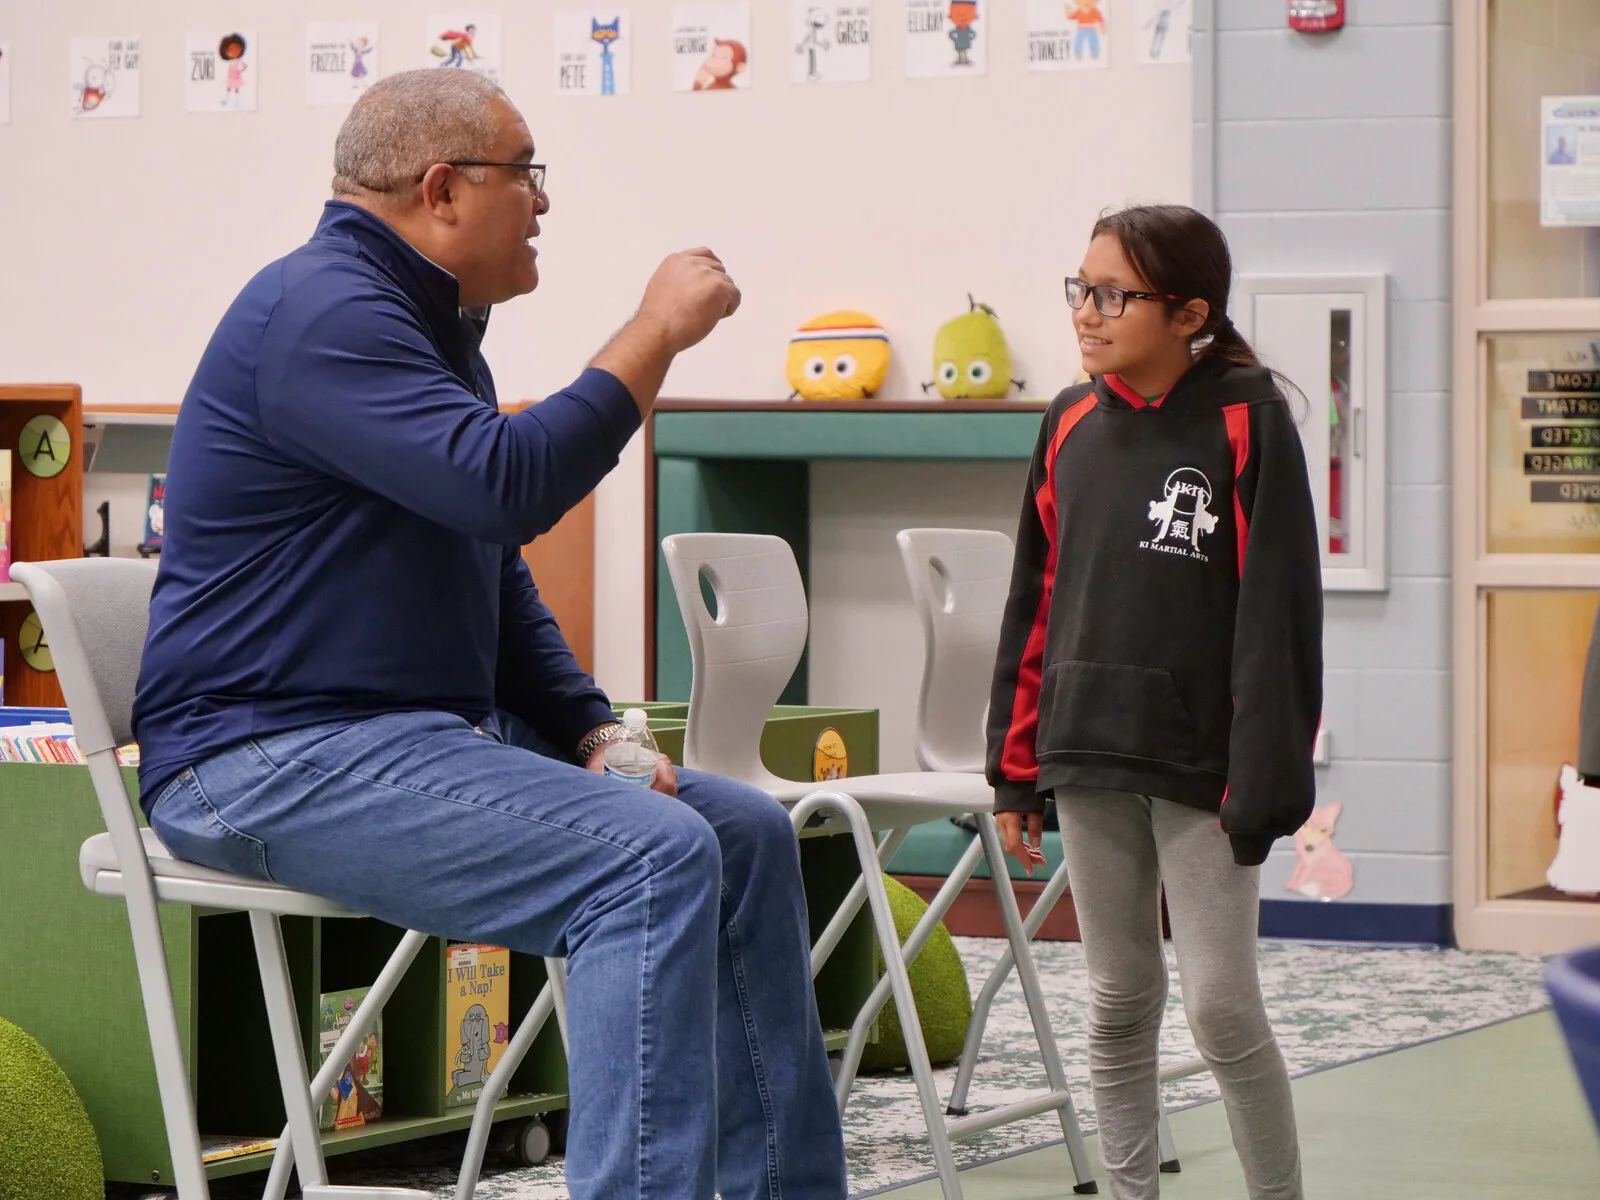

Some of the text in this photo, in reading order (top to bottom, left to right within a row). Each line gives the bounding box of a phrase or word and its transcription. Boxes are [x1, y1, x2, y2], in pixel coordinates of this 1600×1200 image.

[836, 19, 870, 45] GREG
[1028, 39, 1070, 62] STANLEY
[191, 57, 215, 81] ZURI
[310, 52, 347, 73] FRIZZLE
[560, 64, 587, 89] PETE
[33, 429, 56, 462] A
[1139, 541, 1209, 563] KI MARTIAL ARTS
[447, 963, 505, 984] I Will Take
[460, 978, 493, 998] a Nap!
